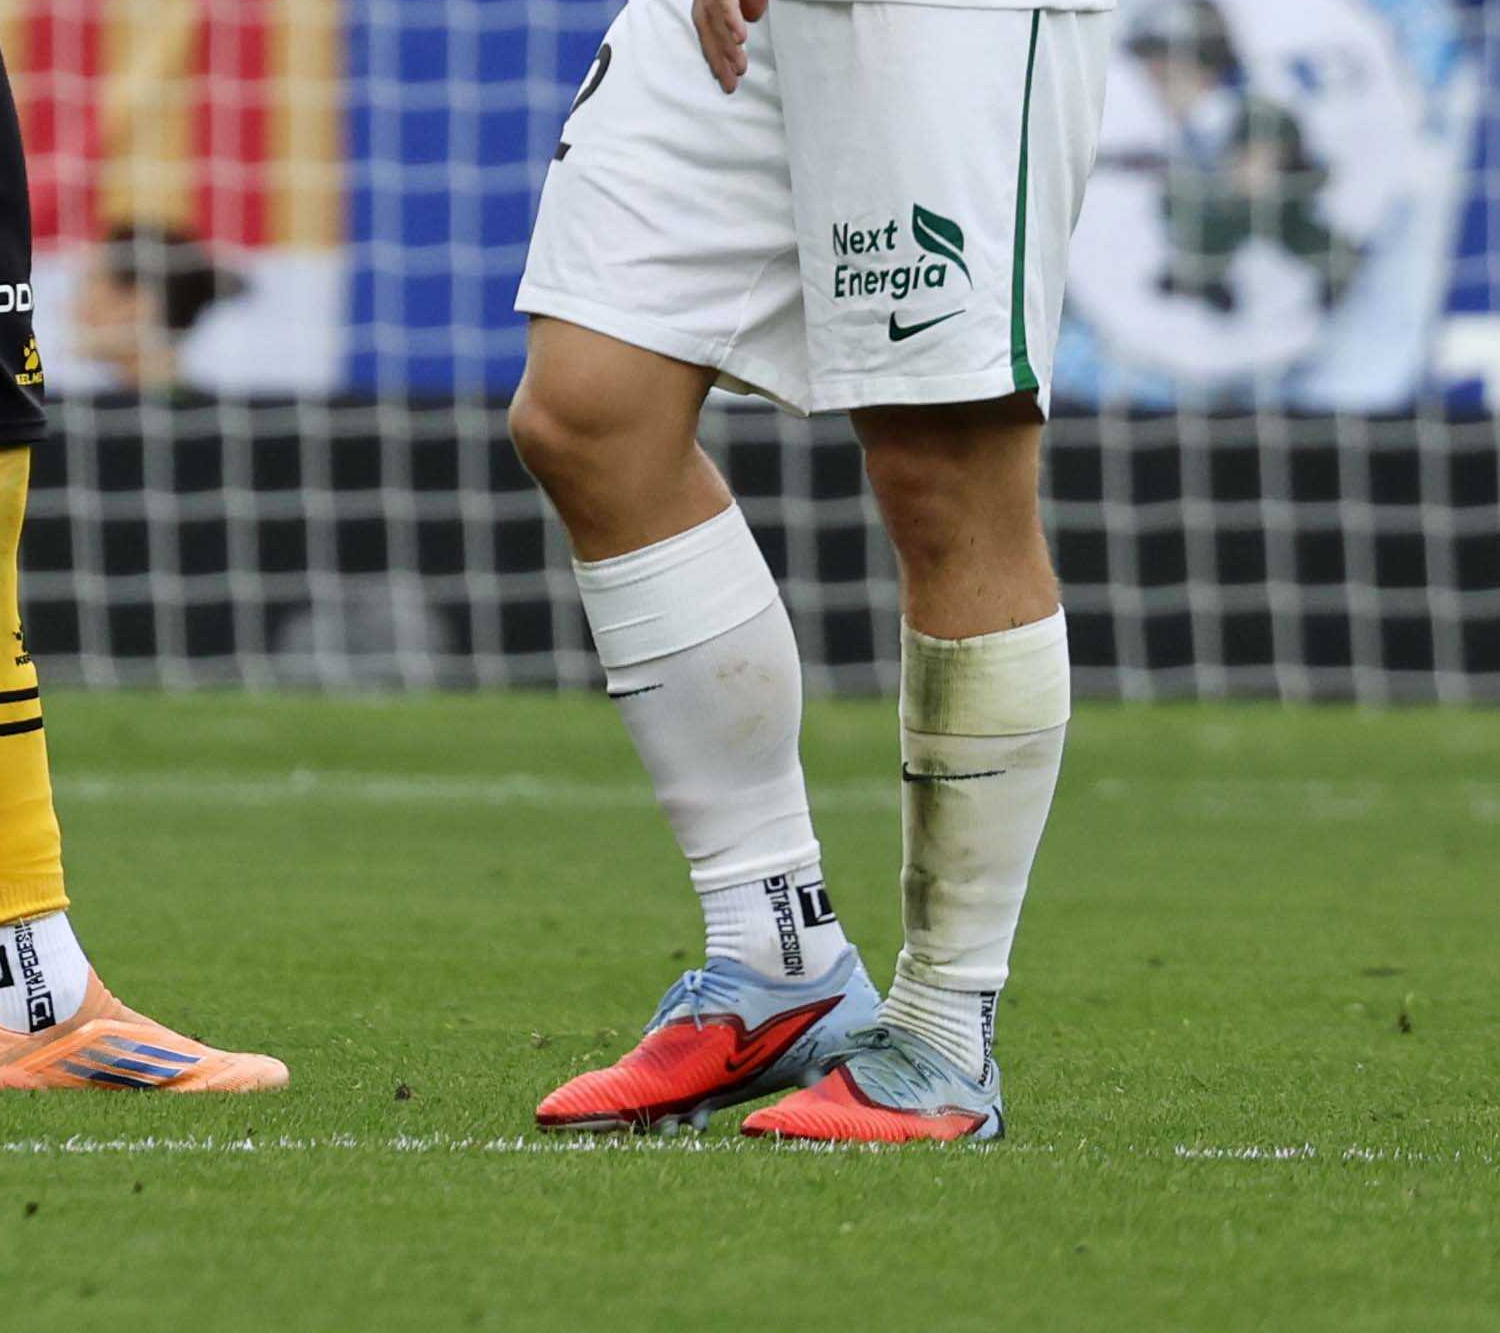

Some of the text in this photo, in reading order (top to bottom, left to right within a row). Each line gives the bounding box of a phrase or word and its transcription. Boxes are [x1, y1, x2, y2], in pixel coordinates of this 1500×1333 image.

[832, 219, 898, 256] Next
[834, 254, 947, 300] Energía
[14, 922, 47, 996] TAPEDESI
[768, 891, 805, 976] TAPEDESIGN
